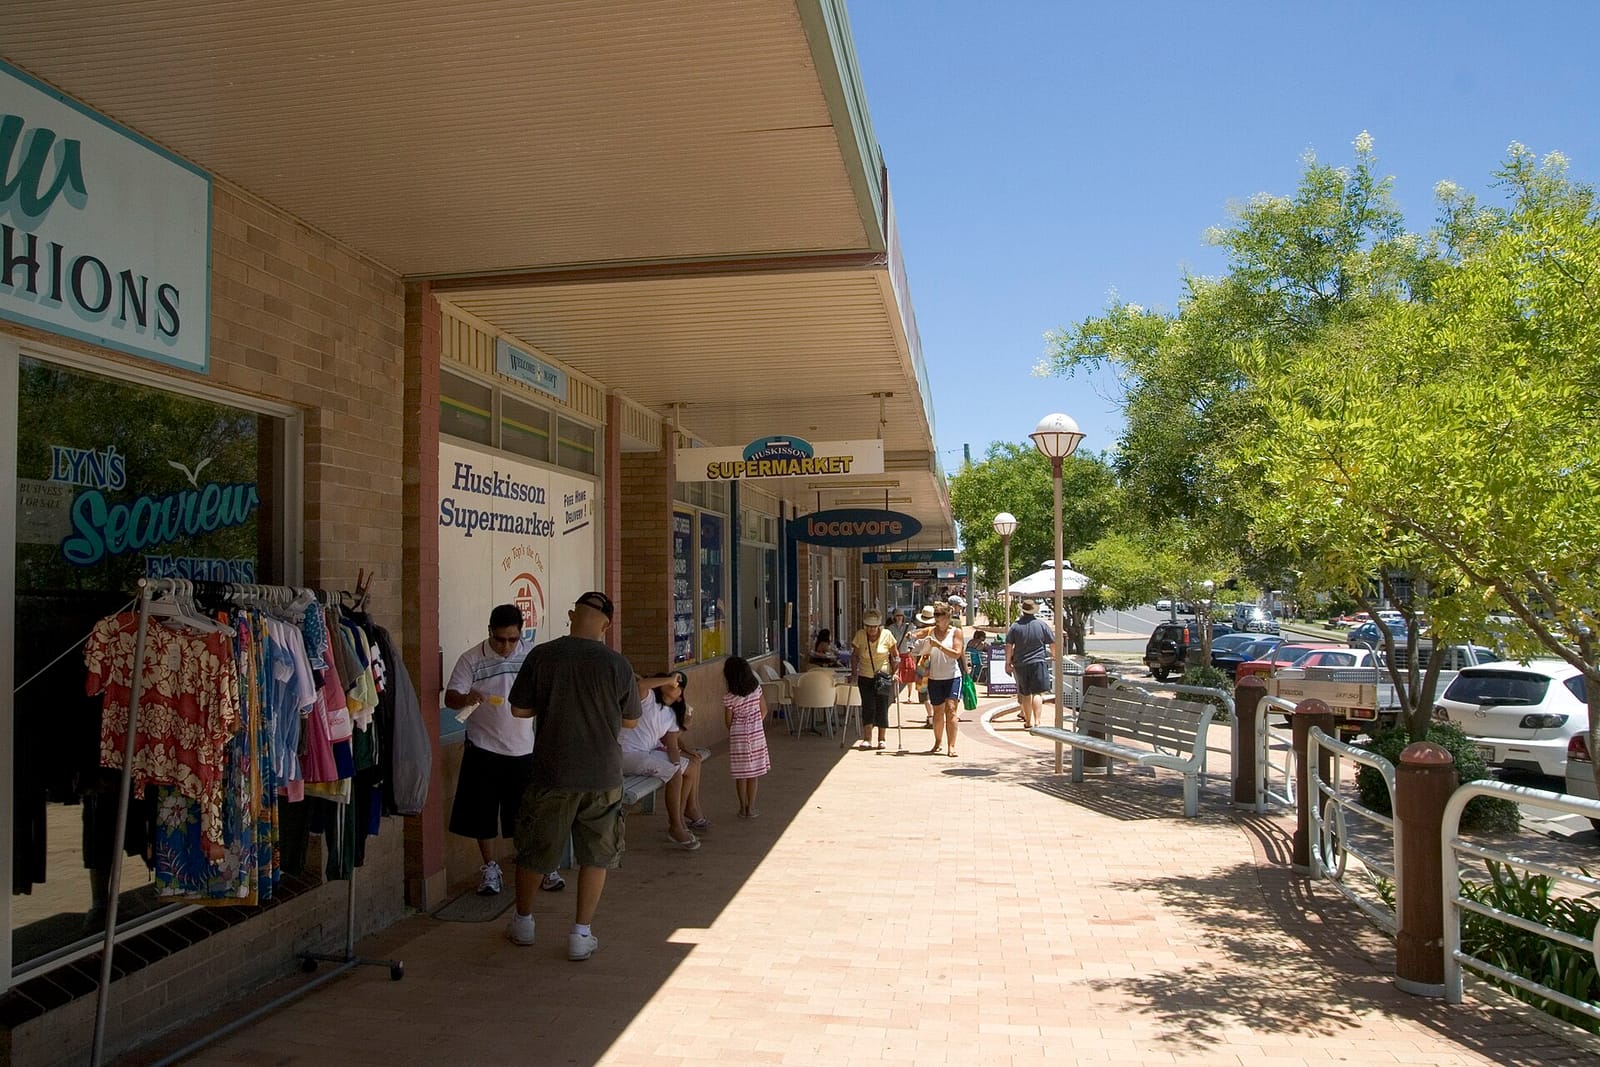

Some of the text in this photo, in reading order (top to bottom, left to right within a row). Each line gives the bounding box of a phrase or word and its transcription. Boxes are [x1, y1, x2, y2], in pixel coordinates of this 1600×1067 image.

[751, 447, 807, 461] HUSKISSON
[50, 446, 126, 491] LYN'S
[707, 455, 853, 480] SUPERMARKET
[20, 483, 63, 496] BUSINESS
[452, 462, 545, 504] Huskisson
[20, 497, 38, 506] FOR
[564, 490, 587, 507] FREE HOME
[62, 483, 260, 566] Seaview
[439, 498, 555, 538] Supermarket
[807, 519, 902, 536] locavore
[145, 555, 256, 584] FASHIONS
[502, 556, 511, 571] Tip
[512, 544, 525, 559] Top's
[526, 546, 534, 559] the
[517, 602, 530, 611] TIP
